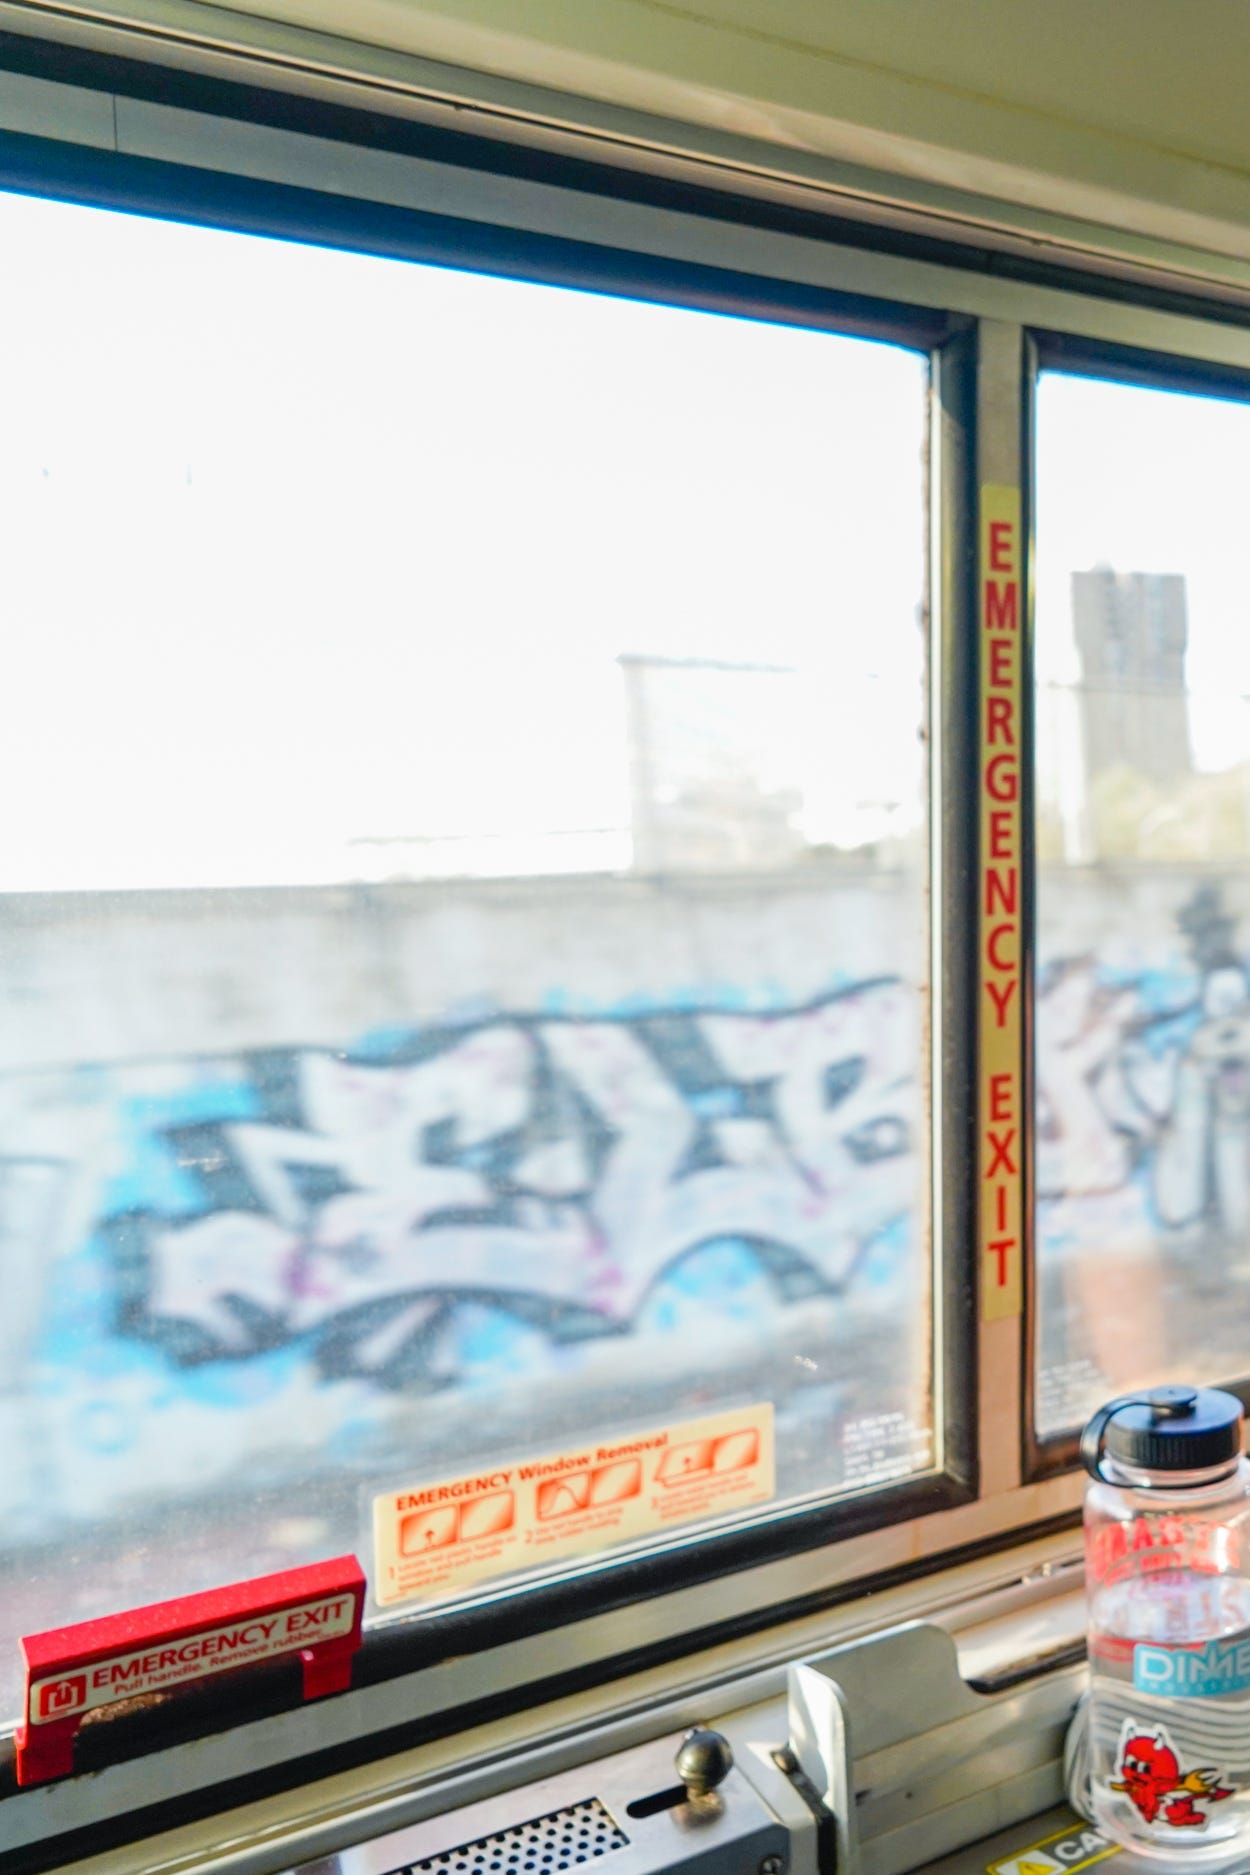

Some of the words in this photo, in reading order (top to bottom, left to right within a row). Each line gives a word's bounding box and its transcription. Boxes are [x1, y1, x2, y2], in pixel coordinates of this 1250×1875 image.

[983, 521, 1020, 1029] EMERGENCY
[984, 1073, 1018, 1288] EXIT
[396, 1470, 513, 1512] EMERGENCY
[518, 1456, 592, 1481] Window
[596, 1432, 669, 1462] Removal
[92, 1619, 279, 1689] EMERGENCY
[285, 1600, 348, 1633] EXIT
[114, 1677, 143, 1695] Pull
[209, 1642, 268, 1667] Remove
